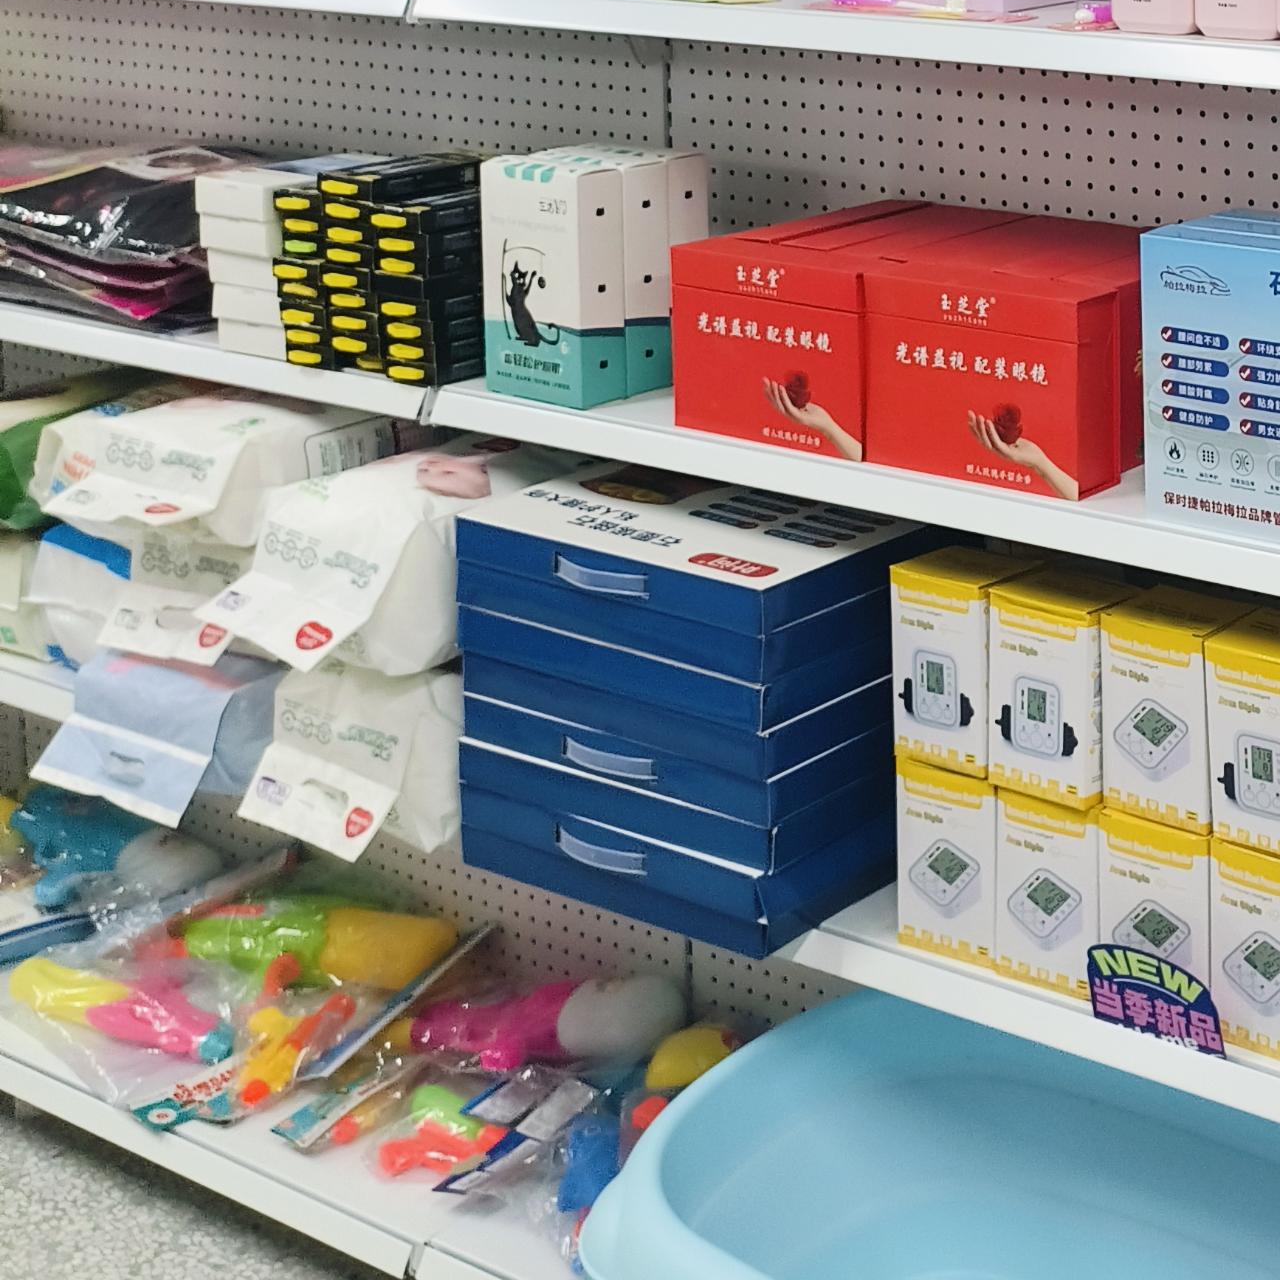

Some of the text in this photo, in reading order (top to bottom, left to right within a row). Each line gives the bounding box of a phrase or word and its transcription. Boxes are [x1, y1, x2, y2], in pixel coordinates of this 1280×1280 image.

[736, 265, 780, 289] 玉芝堂
[940, 293, 990, 317] 玉芝堂
[766, 325, 833, 353] 配装眼镜
[895, 341, 1049, 385] 光谱益视 配装眼镜
[1092, 949, 1203, 1004] NEW
[1094, 977, 1223, 1052] 当季新品
